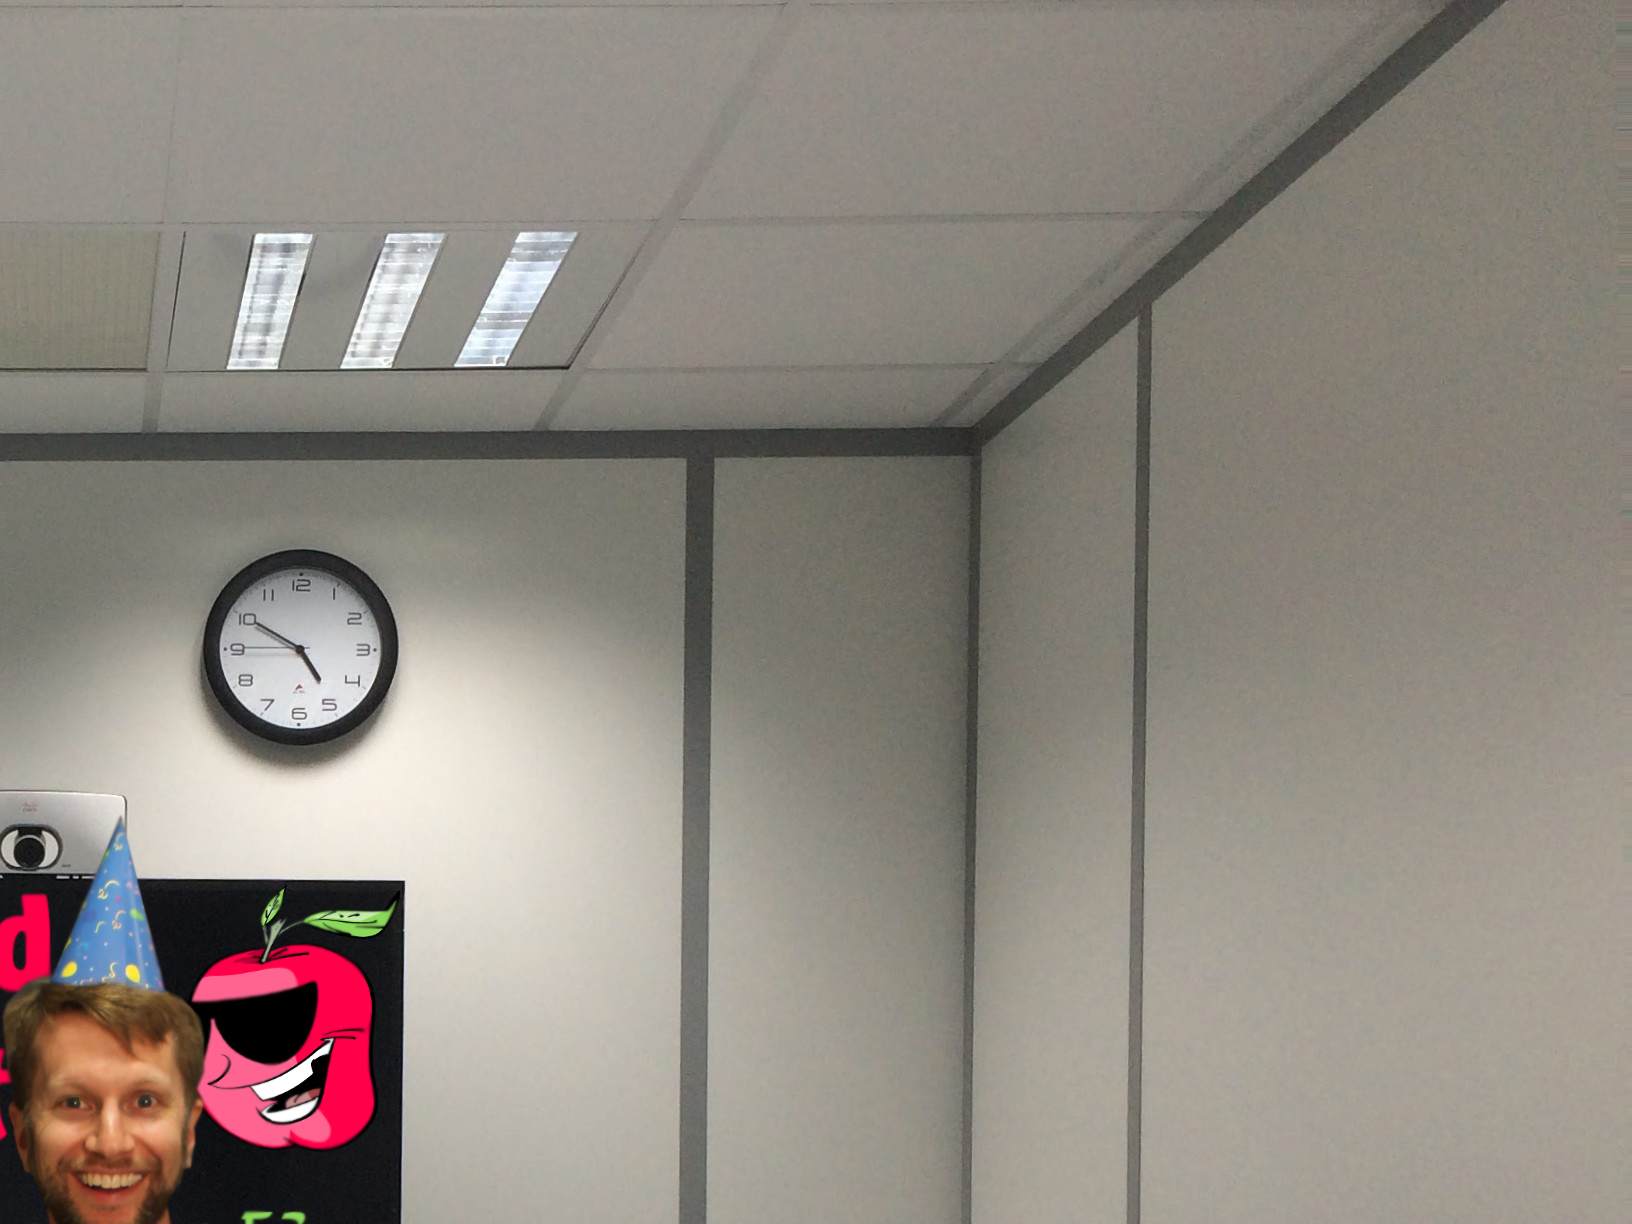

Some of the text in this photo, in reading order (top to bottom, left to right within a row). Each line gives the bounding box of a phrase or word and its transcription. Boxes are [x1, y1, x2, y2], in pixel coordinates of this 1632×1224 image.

[292, 578, 311, 593] 12
[262, 588, 275, 602] 11
[238, 612, 257, 626] 10
[346, 611, 362, 626] 2
[229, 642, 246, 656] 9
[355, 643, 371, 657] 3
[237, 673, 254, 687] 8
[344, 674, 361, 688] 4
[260, 698, 276, 712] 7
[321, 698, 338, 712] 5
[290, 707, 308, 721] 6
